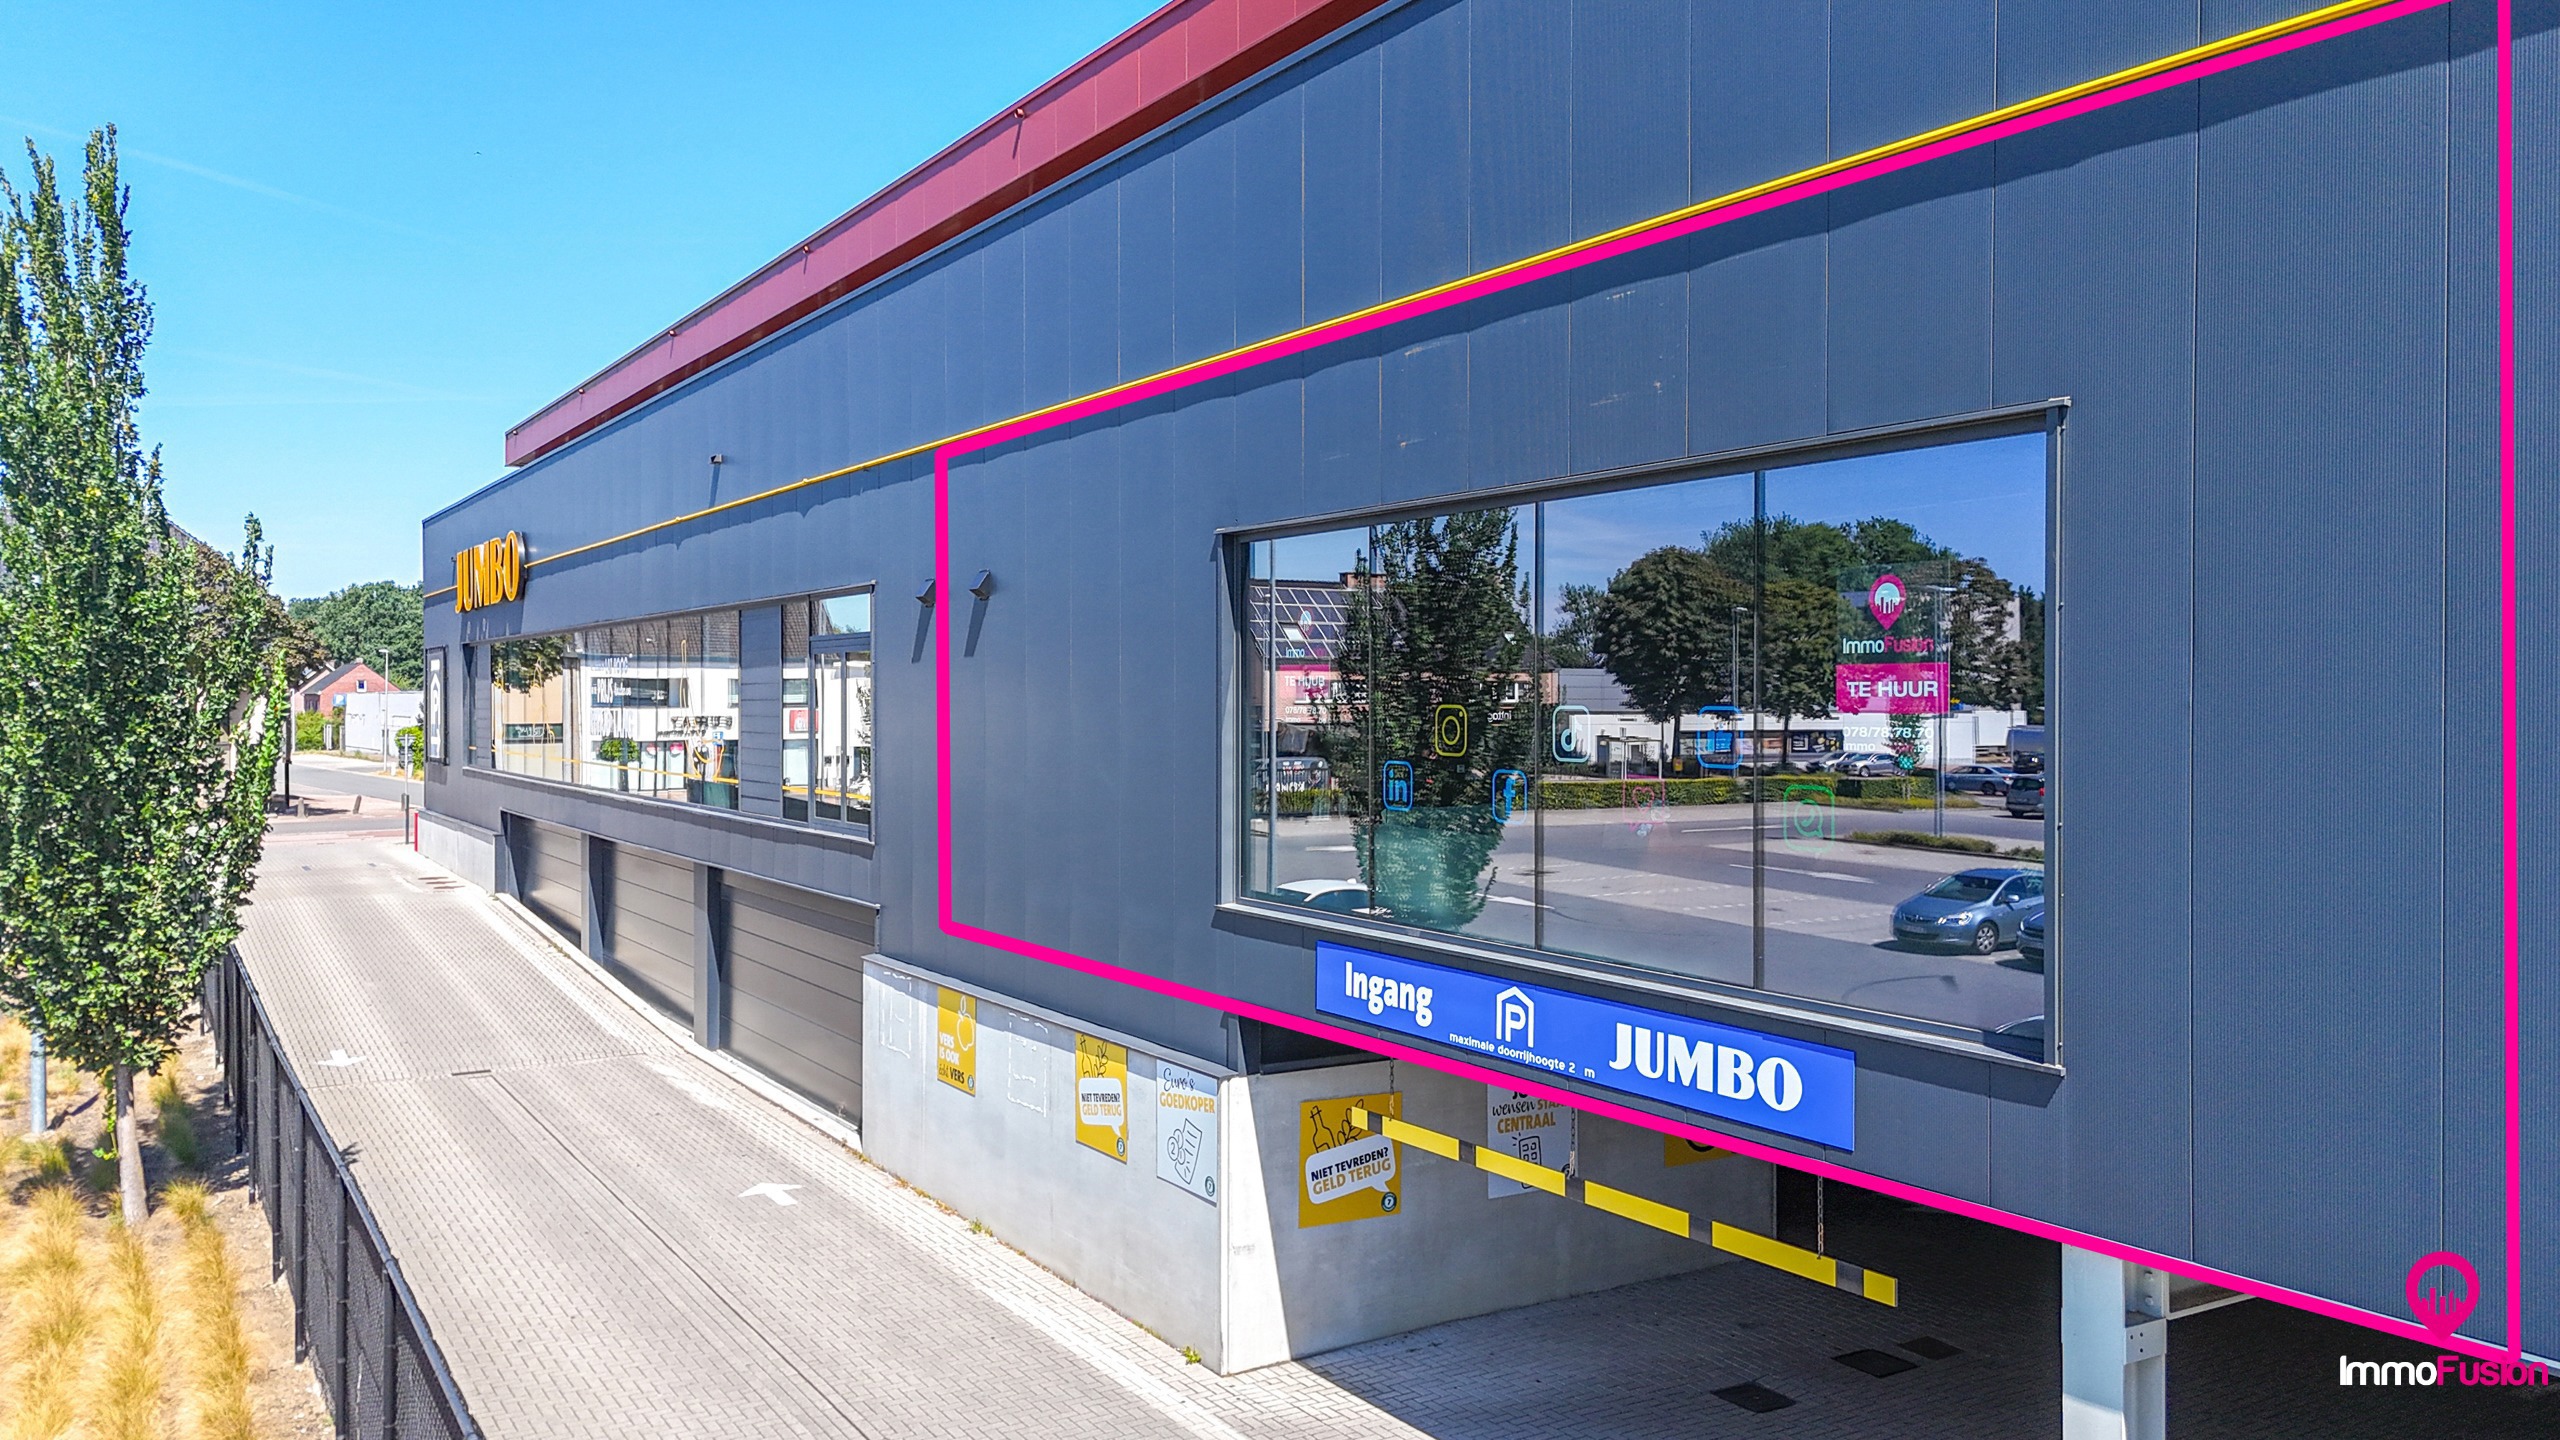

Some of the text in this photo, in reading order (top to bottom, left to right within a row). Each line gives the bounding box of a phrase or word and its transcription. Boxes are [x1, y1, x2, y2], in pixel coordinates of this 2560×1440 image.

[455, 530, 520, 614] JUMBO
[1842, 636, 1935, 654] ImmoFusion
[1847, 681, 1938, 697] TE HUUR
[1345, 961, 1433, 1027] Ingang
[1505, 1002, 1527, 1042] P
[939, 1031, 955, 1049] VERS
[1449, 1033, 1596, 1079] maximale doorrijhoogte 2 m
[1608, 1022, 1803, 1112] JUMBO
[949, 1066, 965, 1085] VERS
[1163, 1067, 1196, 1092] Euro's
[1081, 1093, 1121, 1103] NIET TEVREDEN?
[1160, 1091, 1216, 1114] GOEDKOPER
[1492, 1101, 1536, 1117] wensen
[1082, 1104, 1122, 1117] GELD TERUG
[1497, 1112, 1556, 1134] CENTRAAL
[1311, 1147, 1389, 1182] NIET TEVREDEN?
[1312, 1158, 1391, 1195] GELD TERUG
